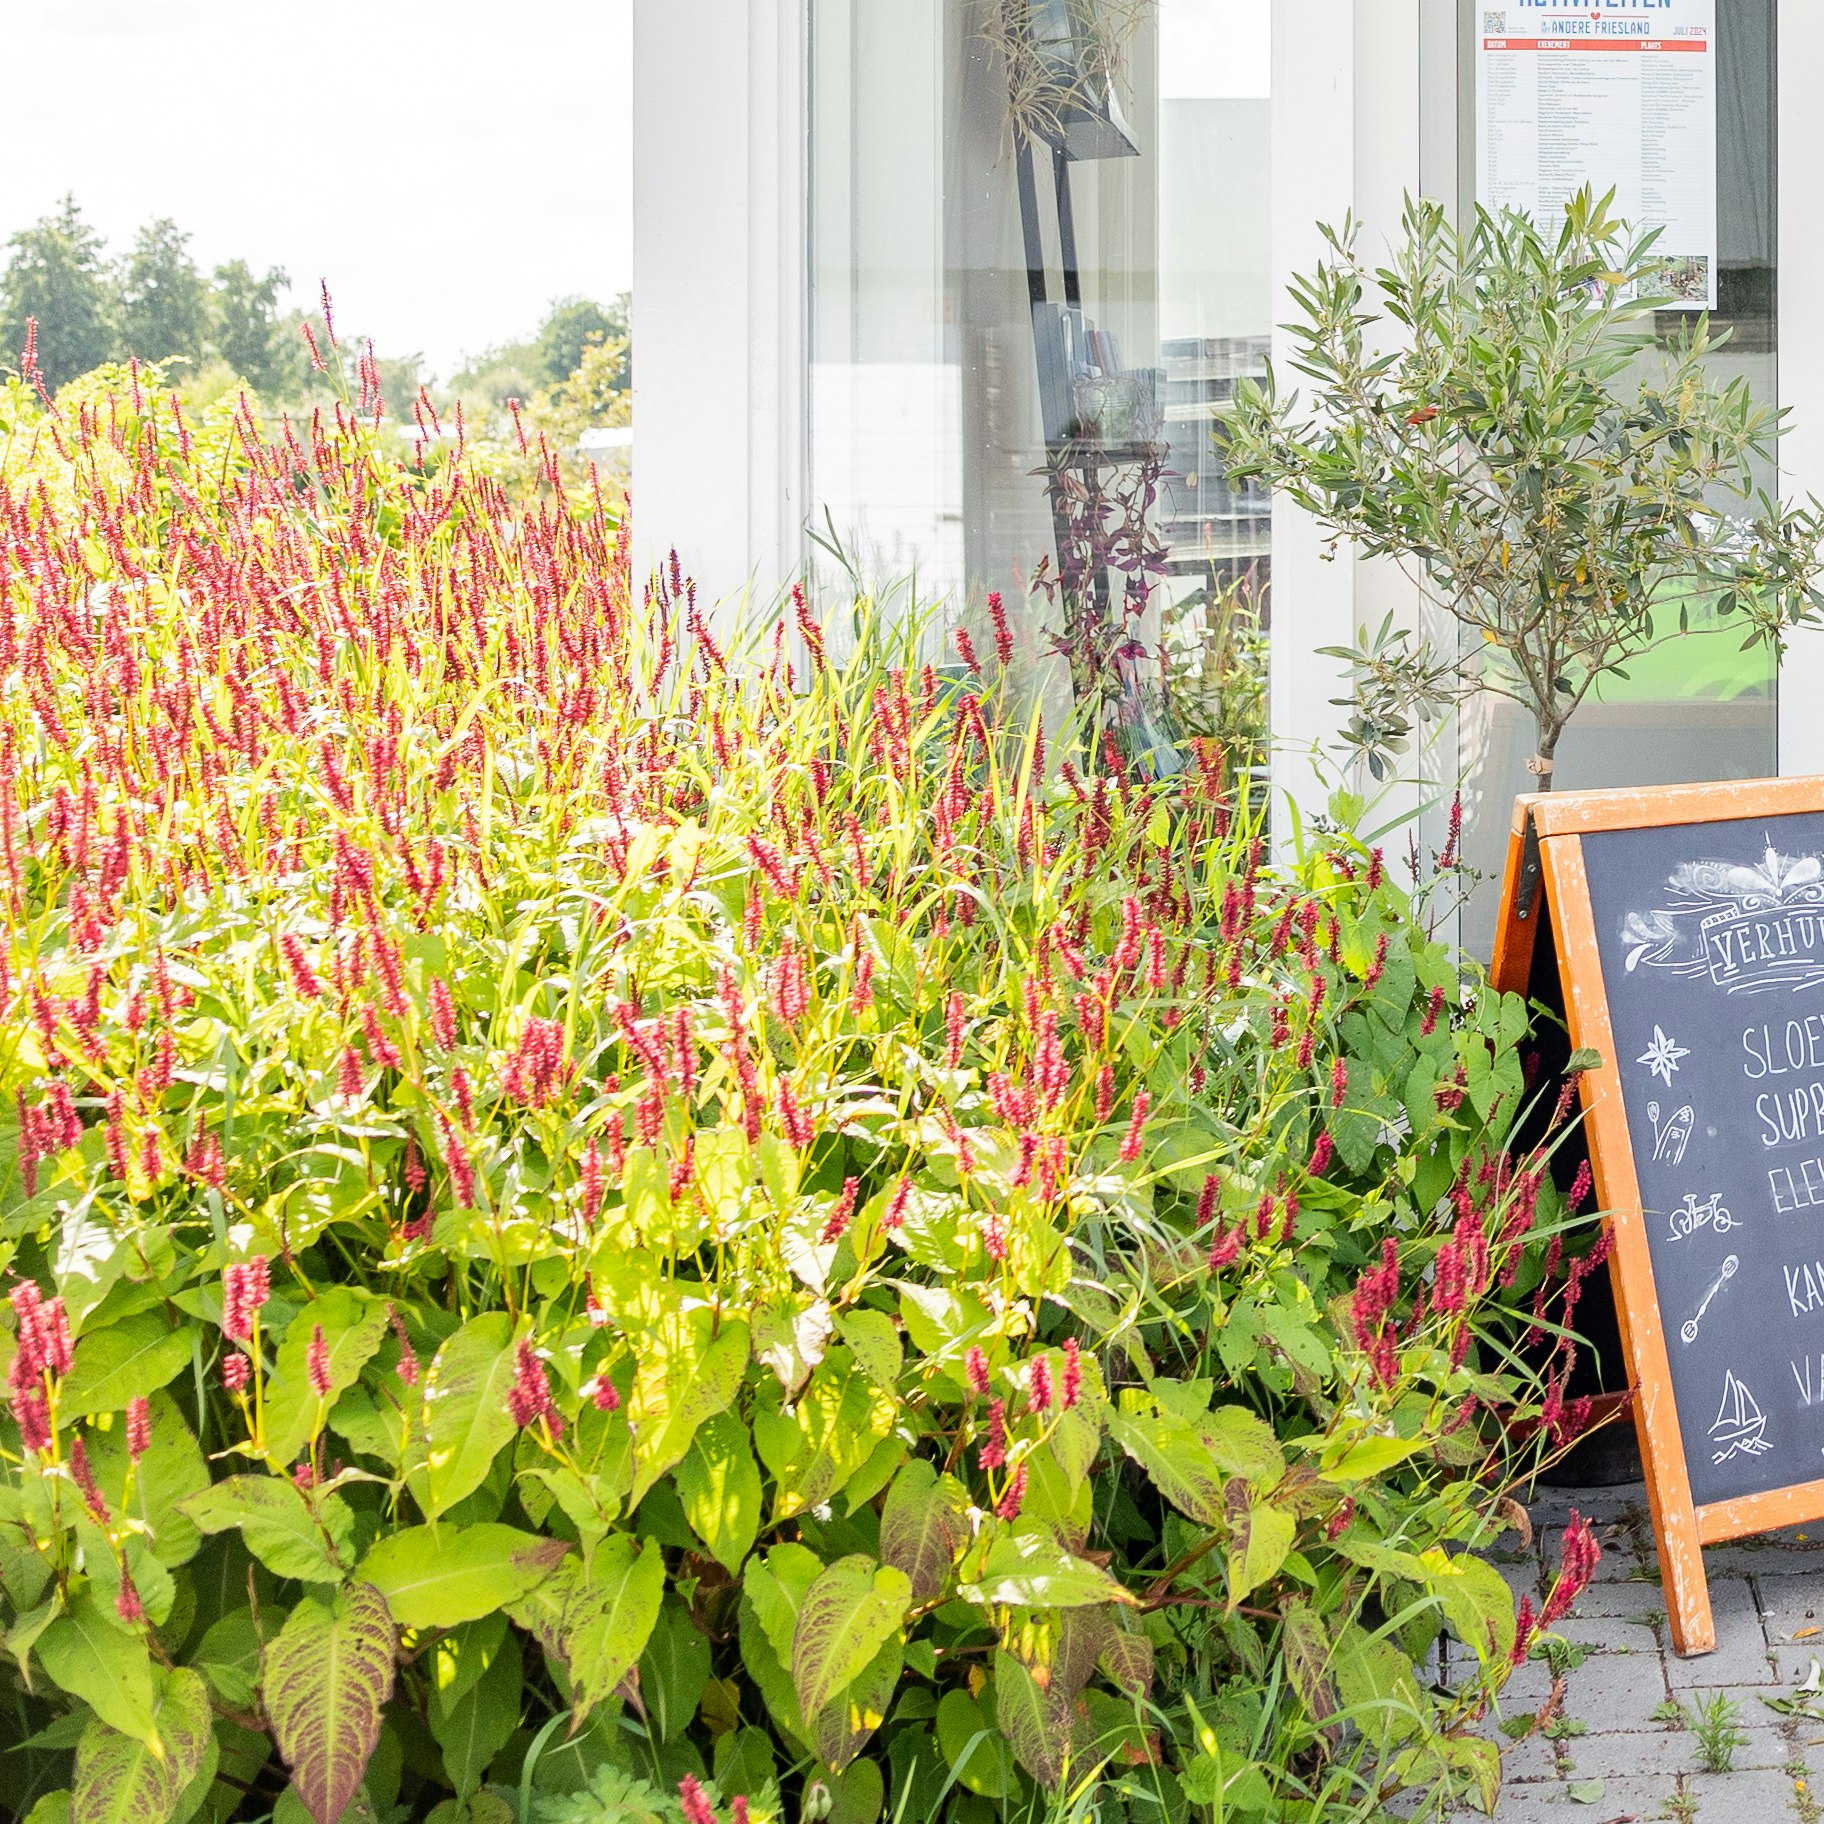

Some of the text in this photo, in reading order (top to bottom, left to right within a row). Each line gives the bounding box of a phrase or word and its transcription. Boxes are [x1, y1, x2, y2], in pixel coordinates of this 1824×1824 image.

[1551, 20, 1650, 35] ANDERE FRIESLAND
[1673, 26, 1688, 36] JULI
